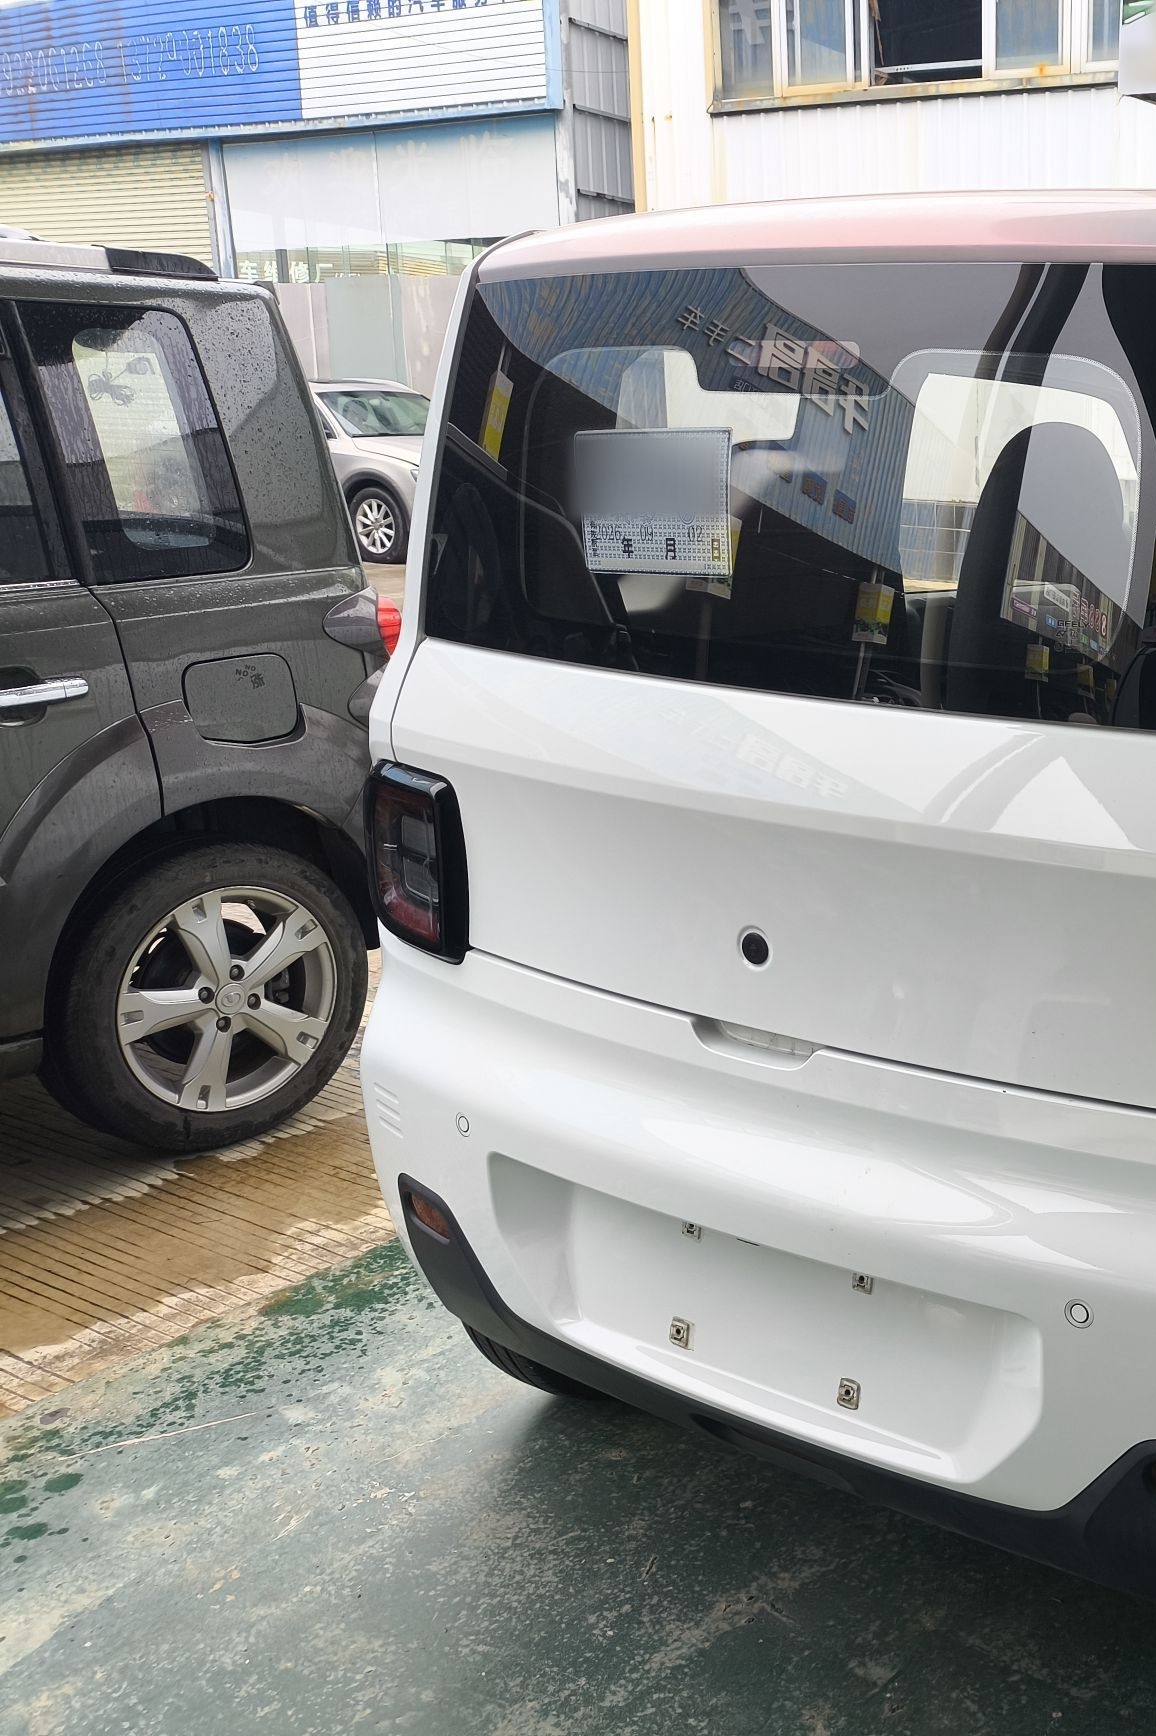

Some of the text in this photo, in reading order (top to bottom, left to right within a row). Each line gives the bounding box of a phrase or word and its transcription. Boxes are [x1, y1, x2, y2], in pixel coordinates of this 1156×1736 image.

[621, 537, 634, 558] 年
[665, 538, 677, 560] 月
[235, 669, 249, 677] NO
